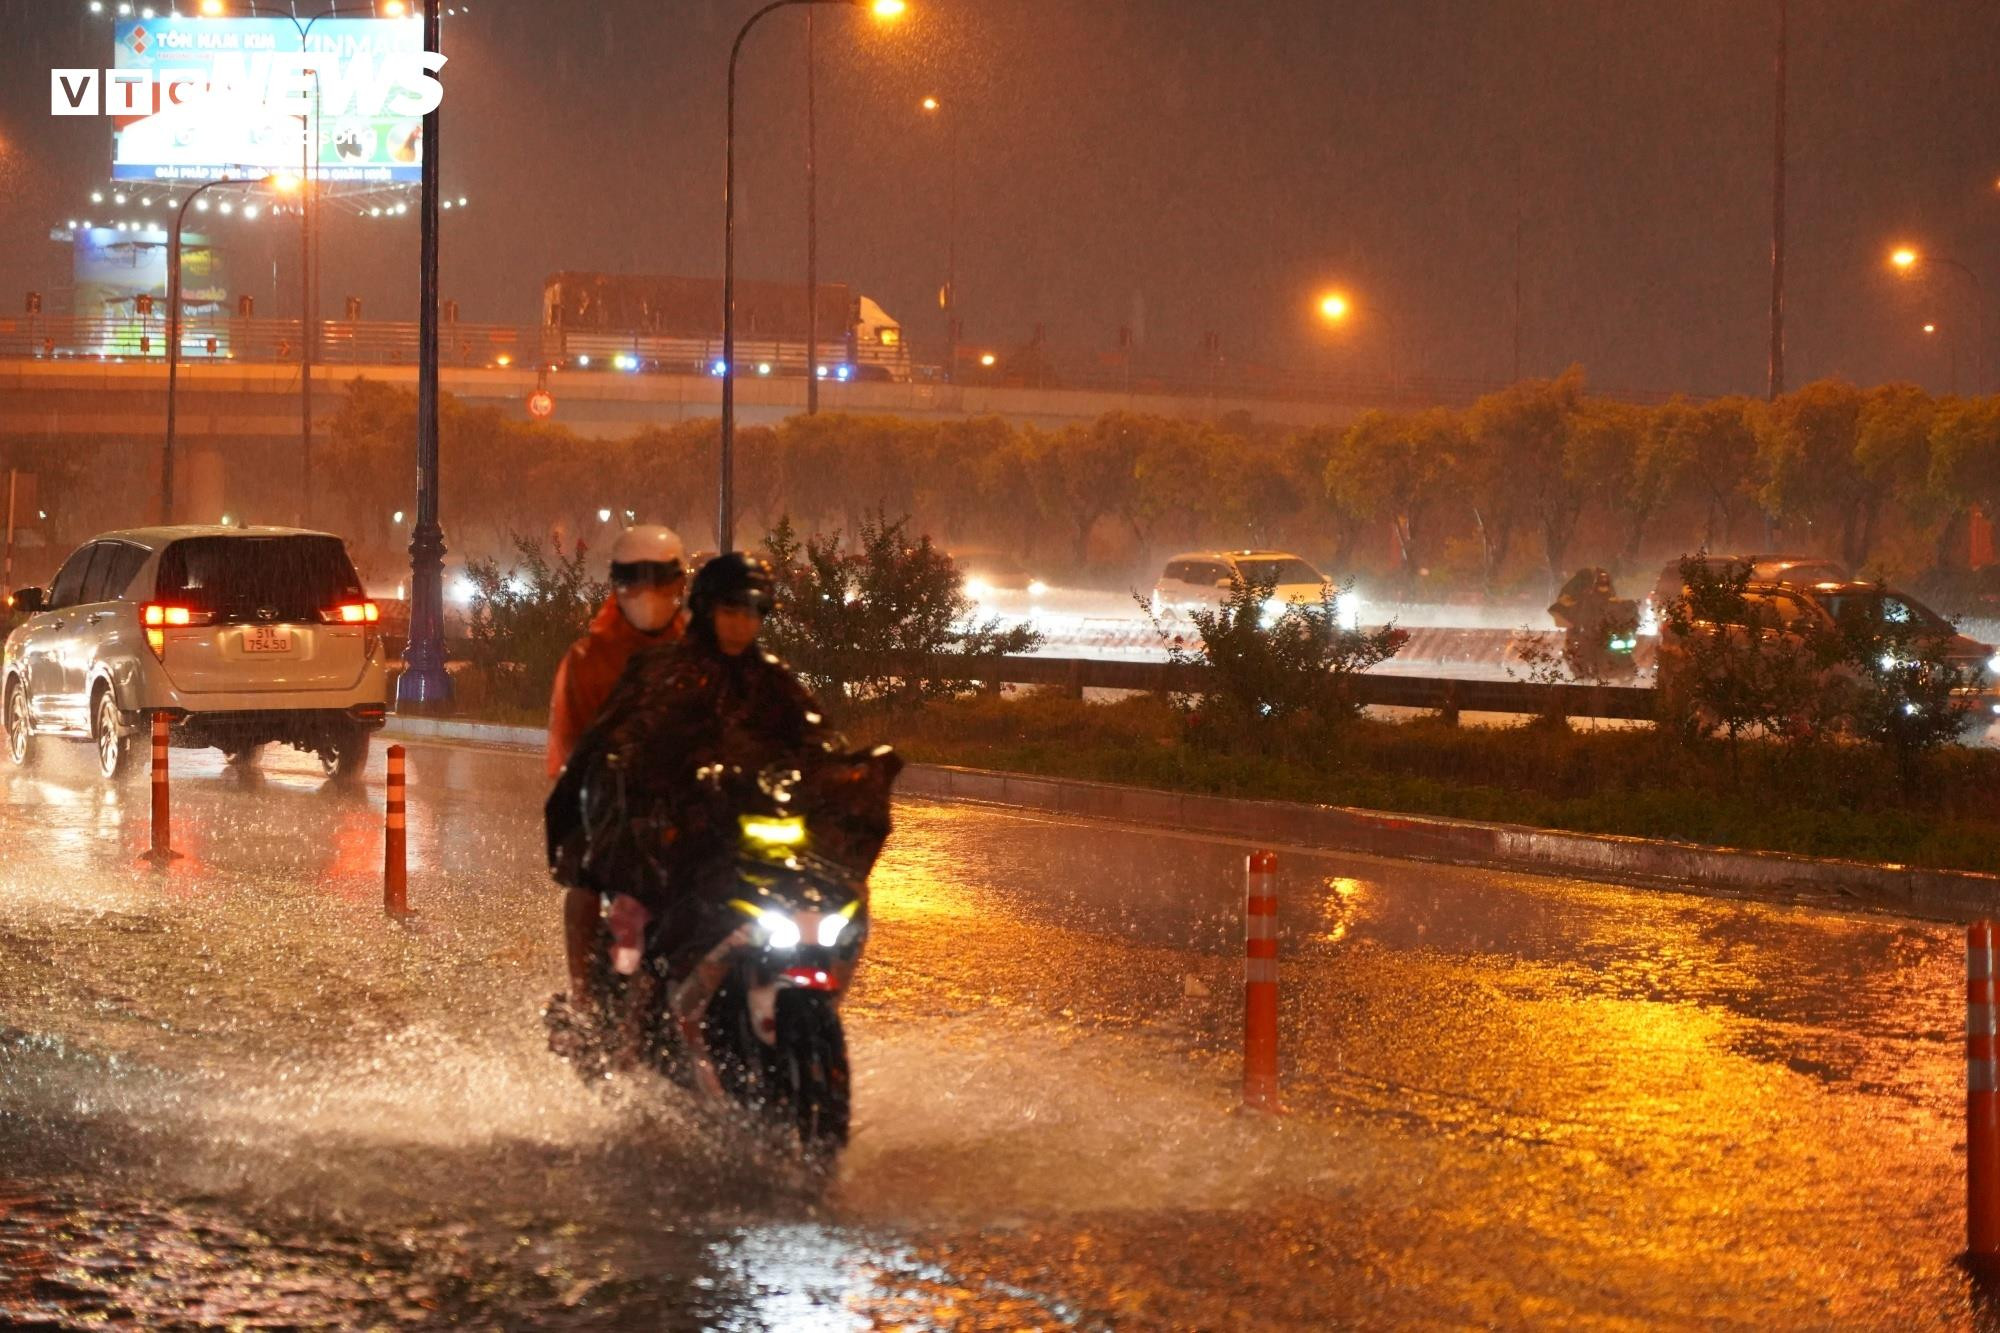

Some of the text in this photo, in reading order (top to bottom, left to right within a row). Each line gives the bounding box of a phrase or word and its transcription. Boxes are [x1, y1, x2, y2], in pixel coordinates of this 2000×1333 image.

[156, 29, 276, 49] TÔN NAM KIM
[248, 639, 287, 650] 754.50
